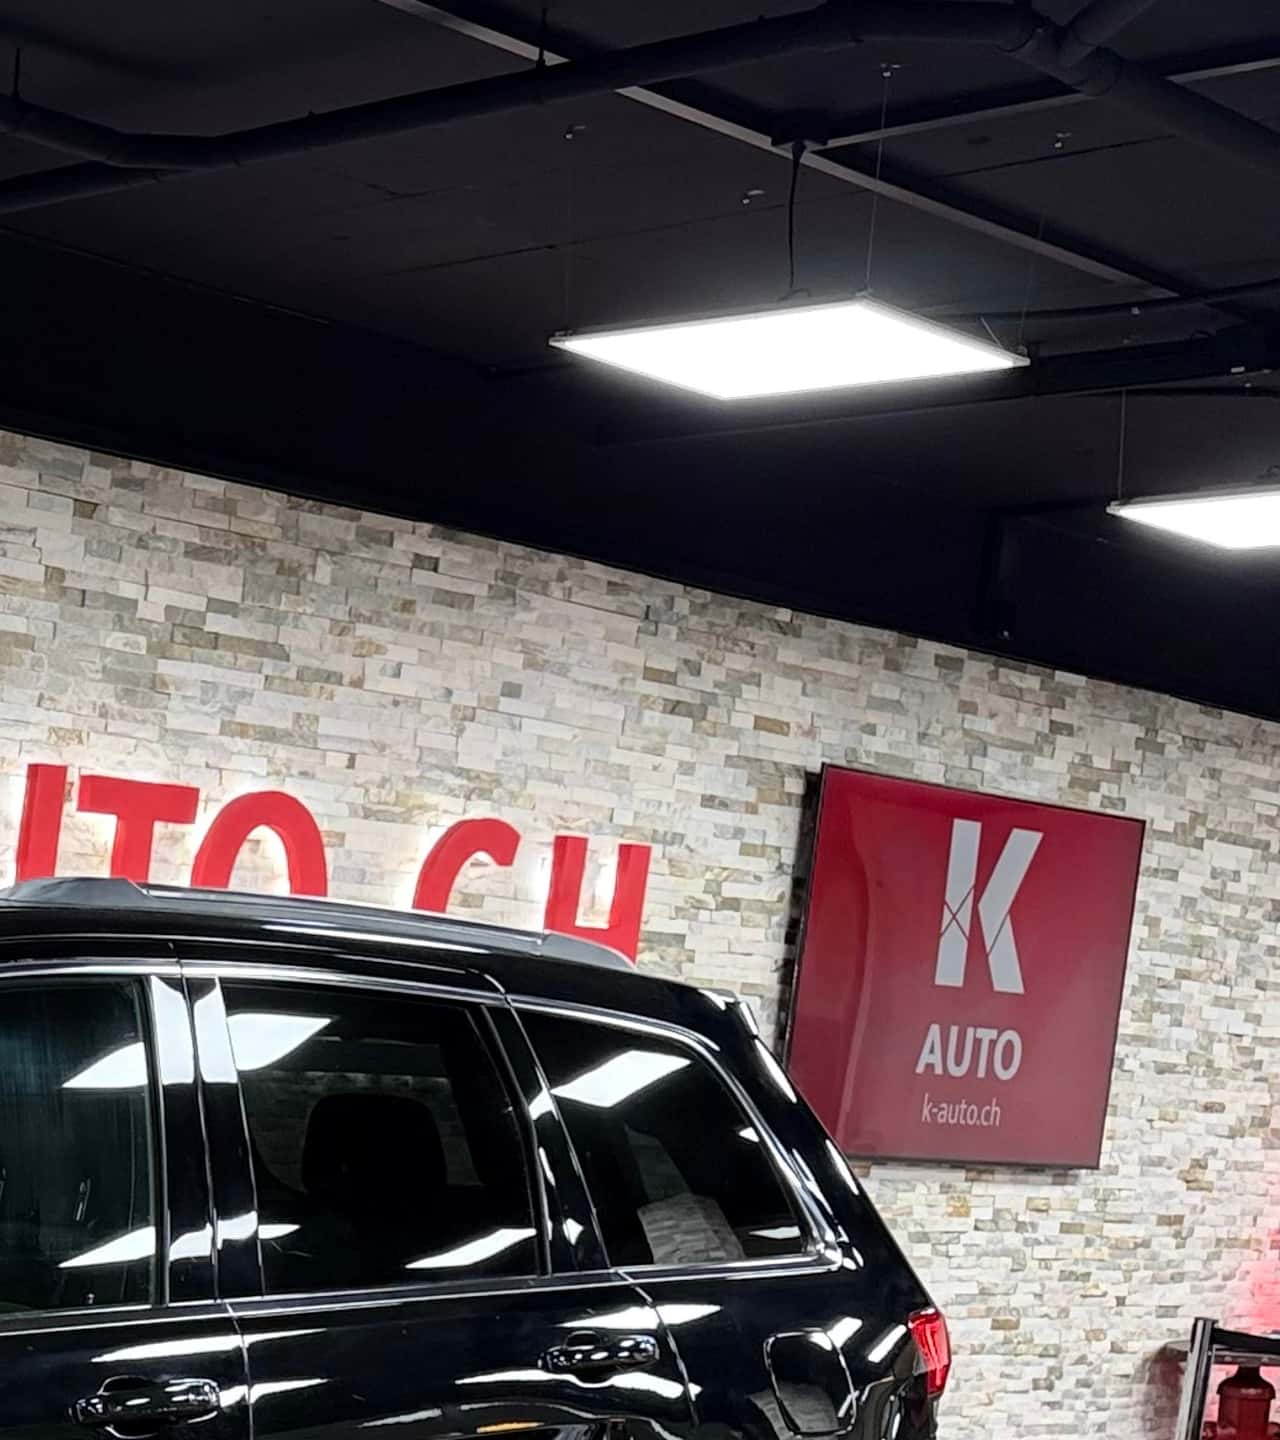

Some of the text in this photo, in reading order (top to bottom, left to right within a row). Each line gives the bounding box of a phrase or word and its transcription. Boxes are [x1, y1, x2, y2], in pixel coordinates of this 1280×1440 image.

[934, 817, 1044, 994] K
[915, 1023, 1023, 1081] AUTO
[921, 1093, 1002, 1128] k-auto.ch
